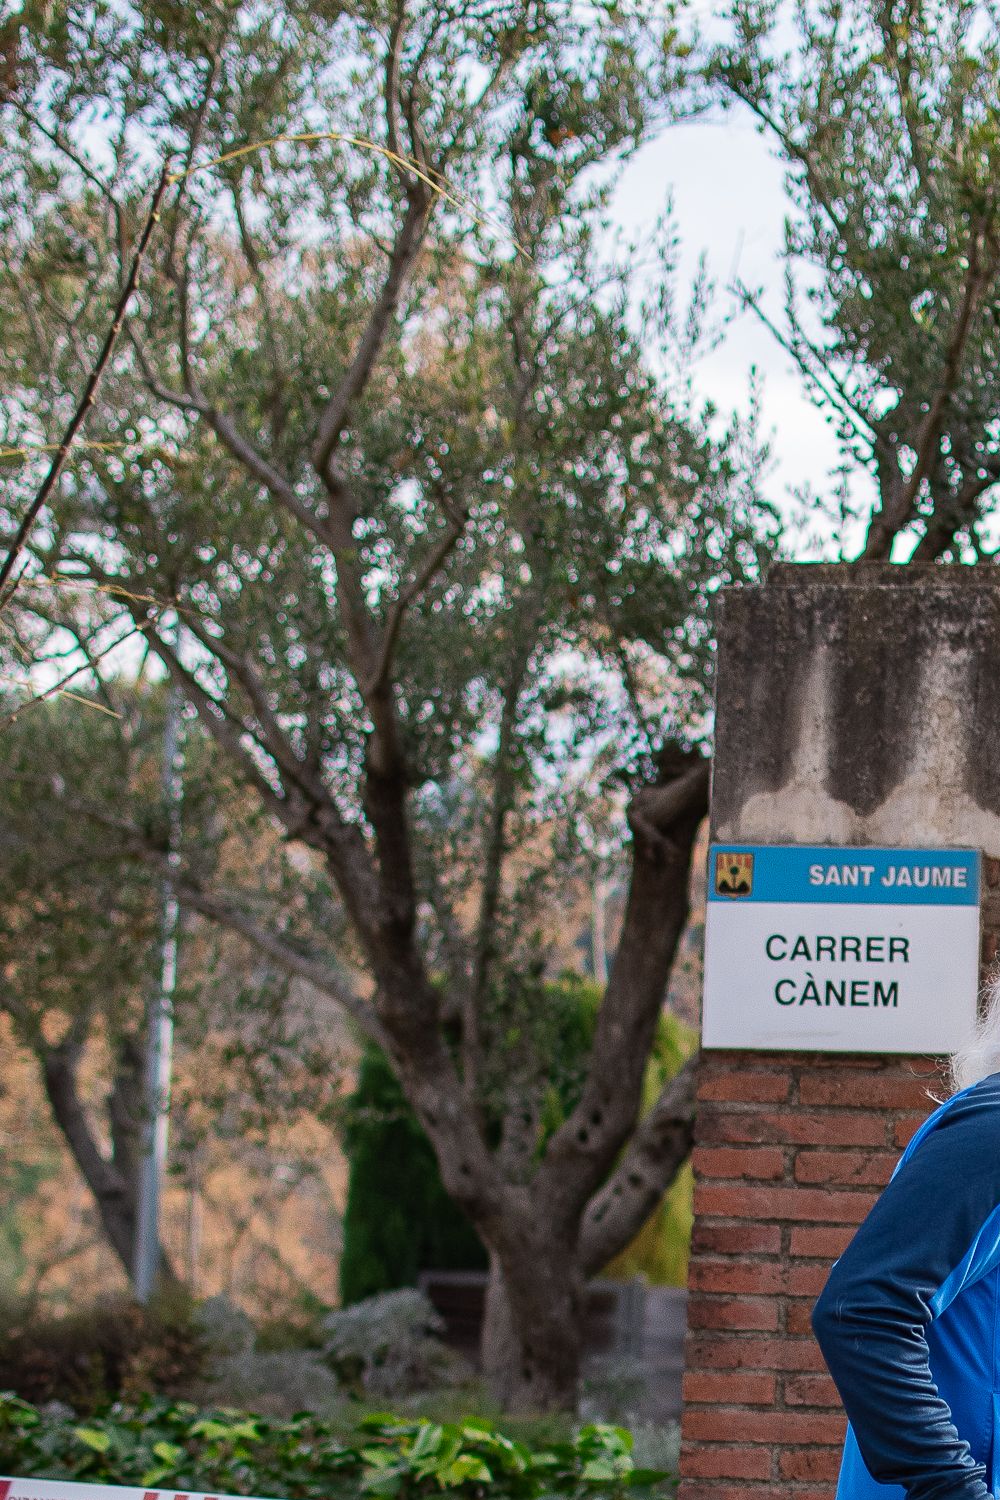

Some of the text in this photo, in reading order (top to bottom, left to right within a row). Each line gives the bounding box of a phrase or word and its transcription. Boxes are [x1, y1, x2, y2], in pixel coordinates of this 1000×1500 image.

[809, 864, 968, 888] SANT JAUME
[765, 934, 911, 963] CARRER
[774, 972, 900, 1008] CÀNEM
